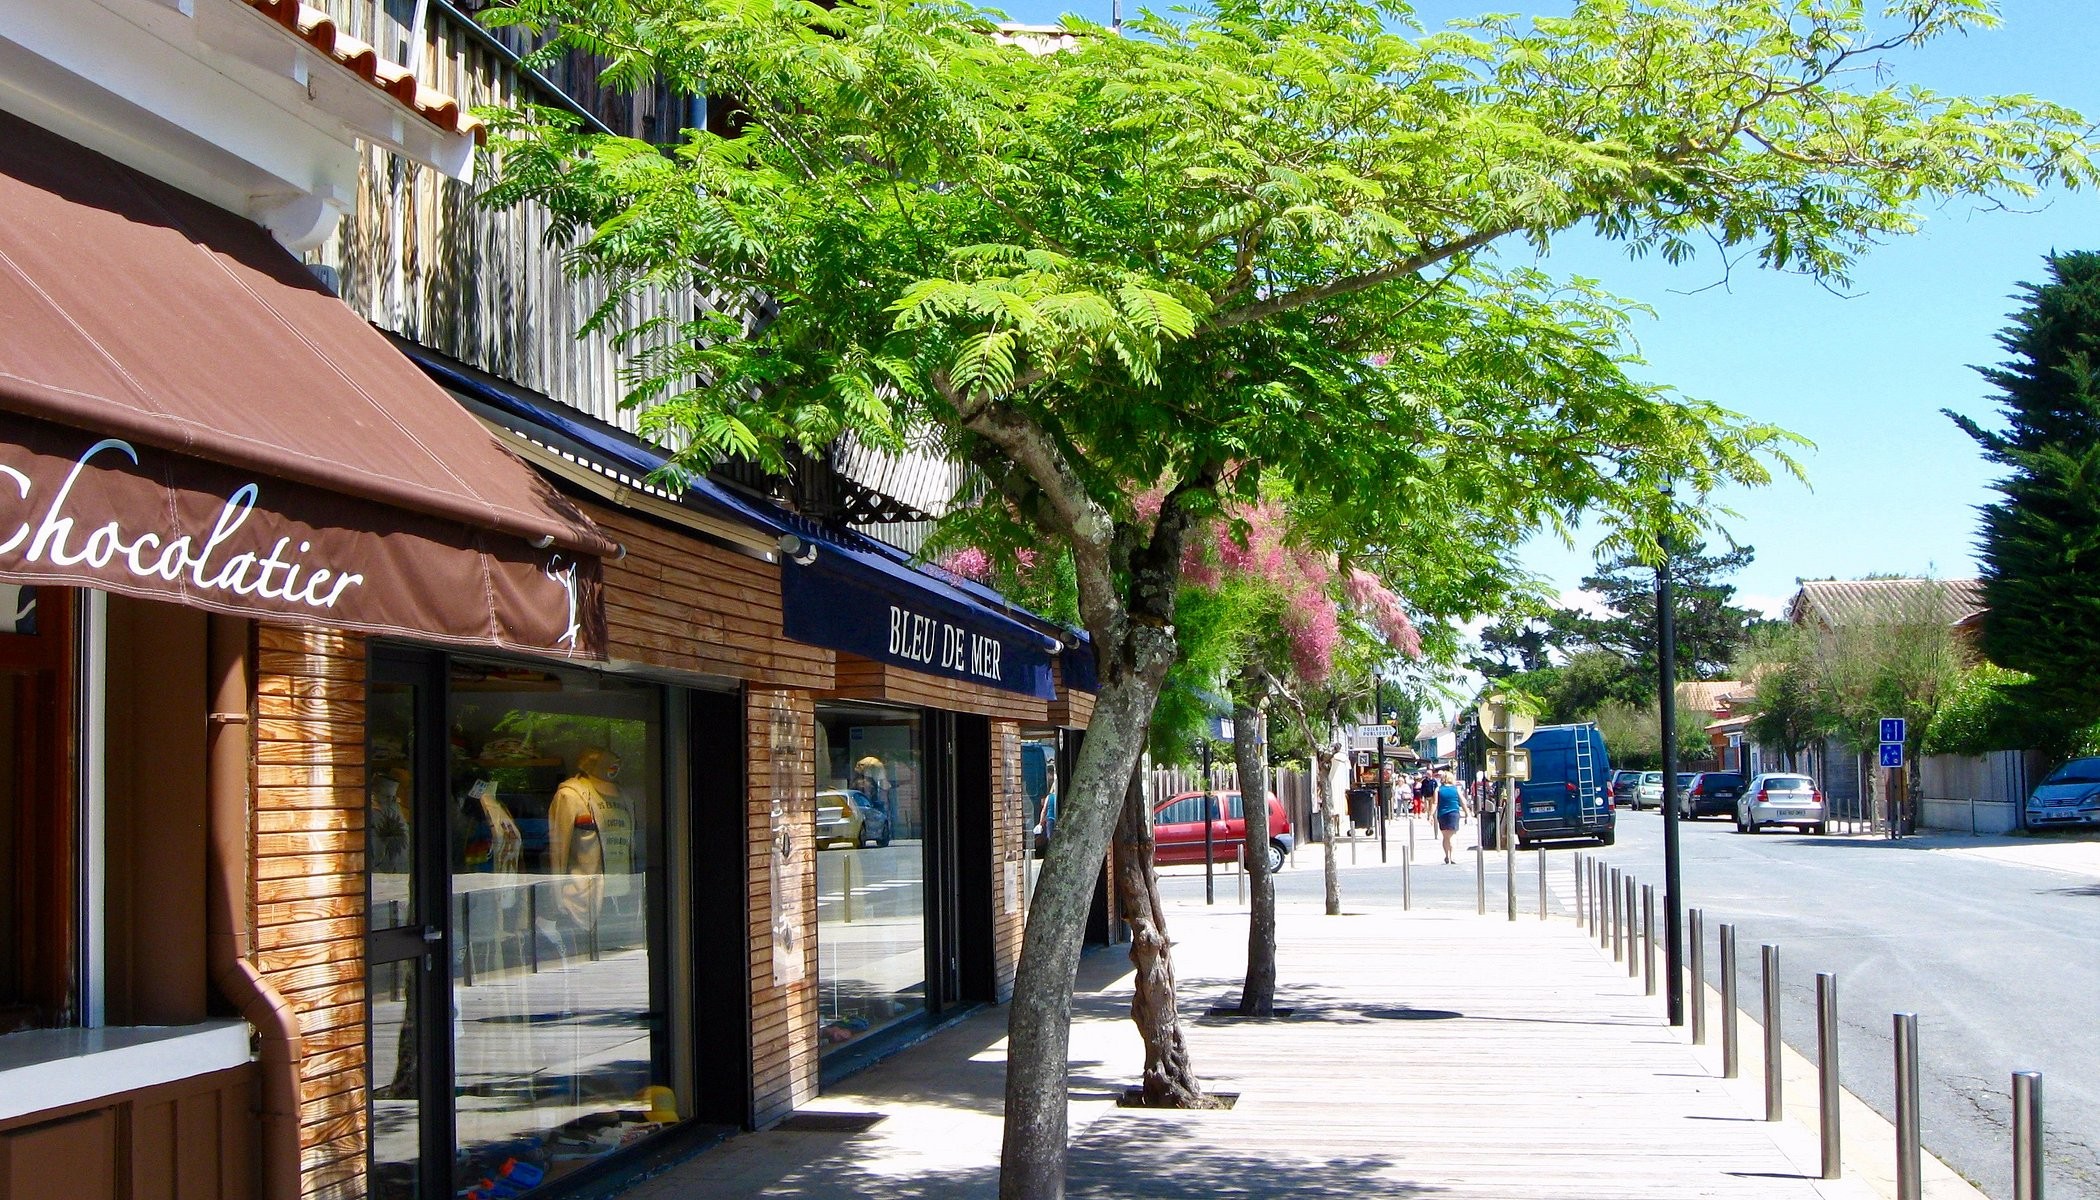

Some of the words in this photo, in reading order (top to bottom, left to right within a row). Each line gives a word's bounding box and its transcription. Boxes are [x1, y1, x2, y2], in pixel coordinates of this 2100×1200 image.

[889, 605, 937, 664] BLEU
[941, 624, 965, 671] DE
[971, 633, 1002, 681] MER
